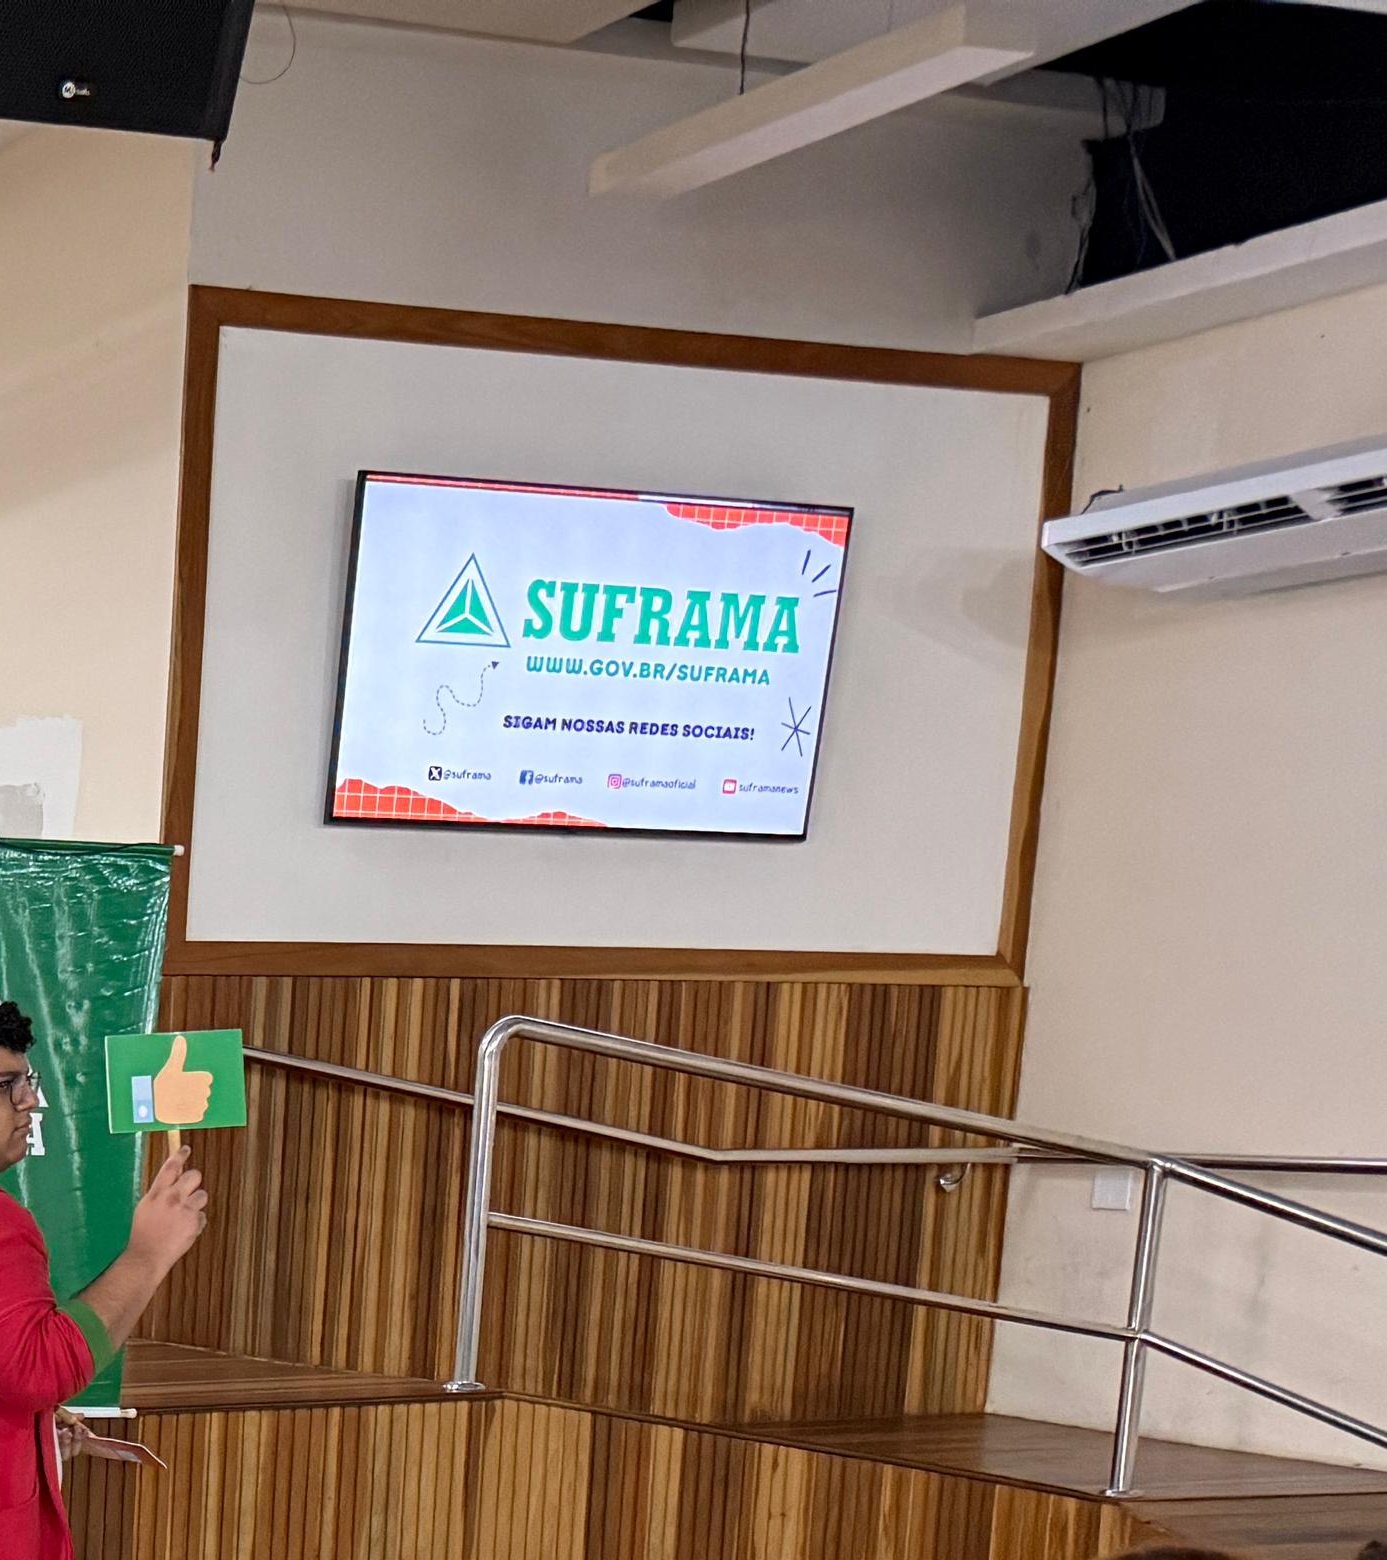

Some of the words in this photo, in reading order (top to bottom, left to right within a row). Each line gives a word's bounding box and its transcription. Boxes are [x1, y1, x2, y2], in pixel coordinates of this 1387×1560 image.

[523, 579, 800, 654] SUFRAMA
[526, 655, 770, 686] WWW.GOV.BR/SUFRAMA
[503, 715, 557, 731] SIGAM
[561, 718, 625, 734] NOSSAS
[629, 721, 678, 737] REDES
[682, 725, 755, 741] SOCIAIS!
[443, 769, 492, 781] @suframa
[535, 773, 583, 785] @suframa
